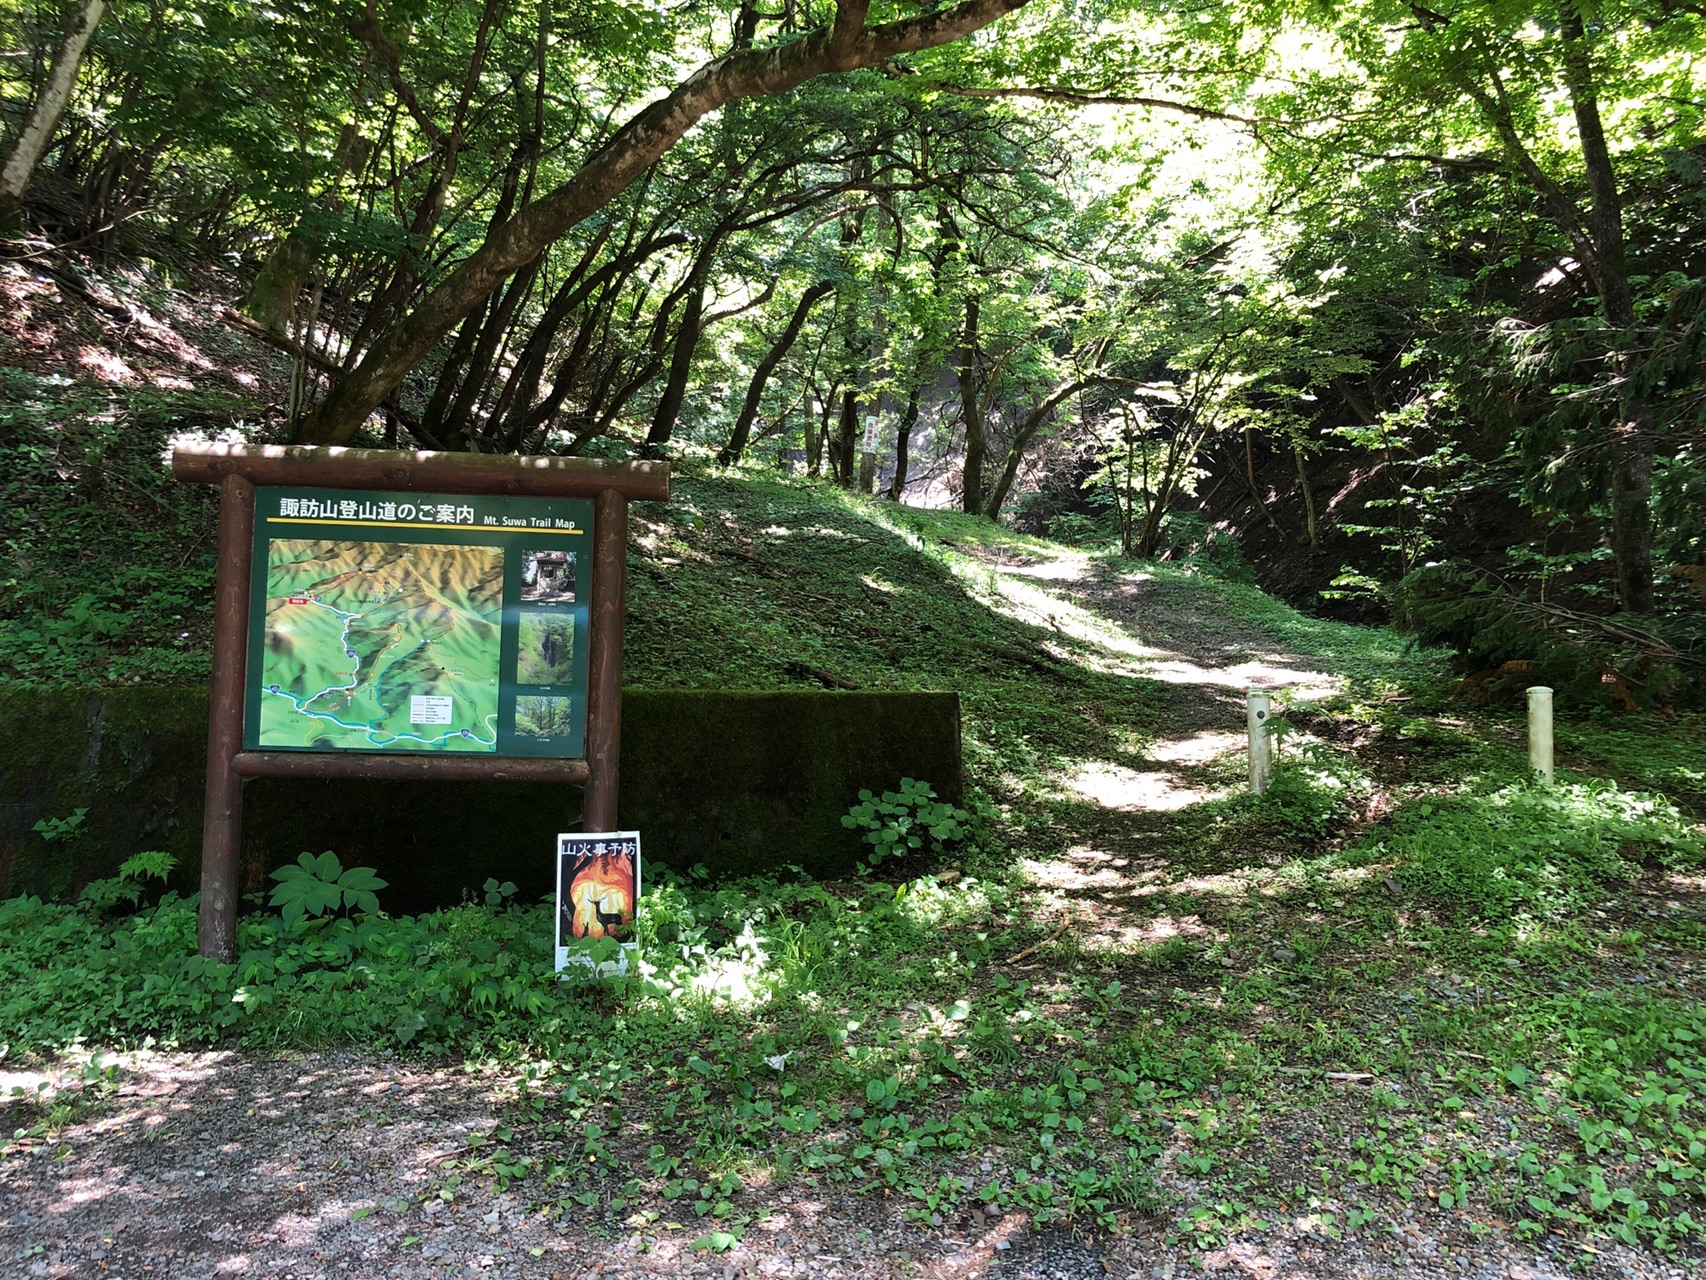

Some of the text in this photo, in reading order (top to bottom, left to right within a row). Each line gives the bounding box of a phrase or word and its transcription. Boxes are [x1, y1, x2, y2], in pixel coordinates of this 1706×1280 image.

[280, 497, 475, 524] 諏訪山登山道のご案内
[484, 516, 575, 531] Mt. Suwa Trail Map
[562, 842, 637, 857] 山火事予防
